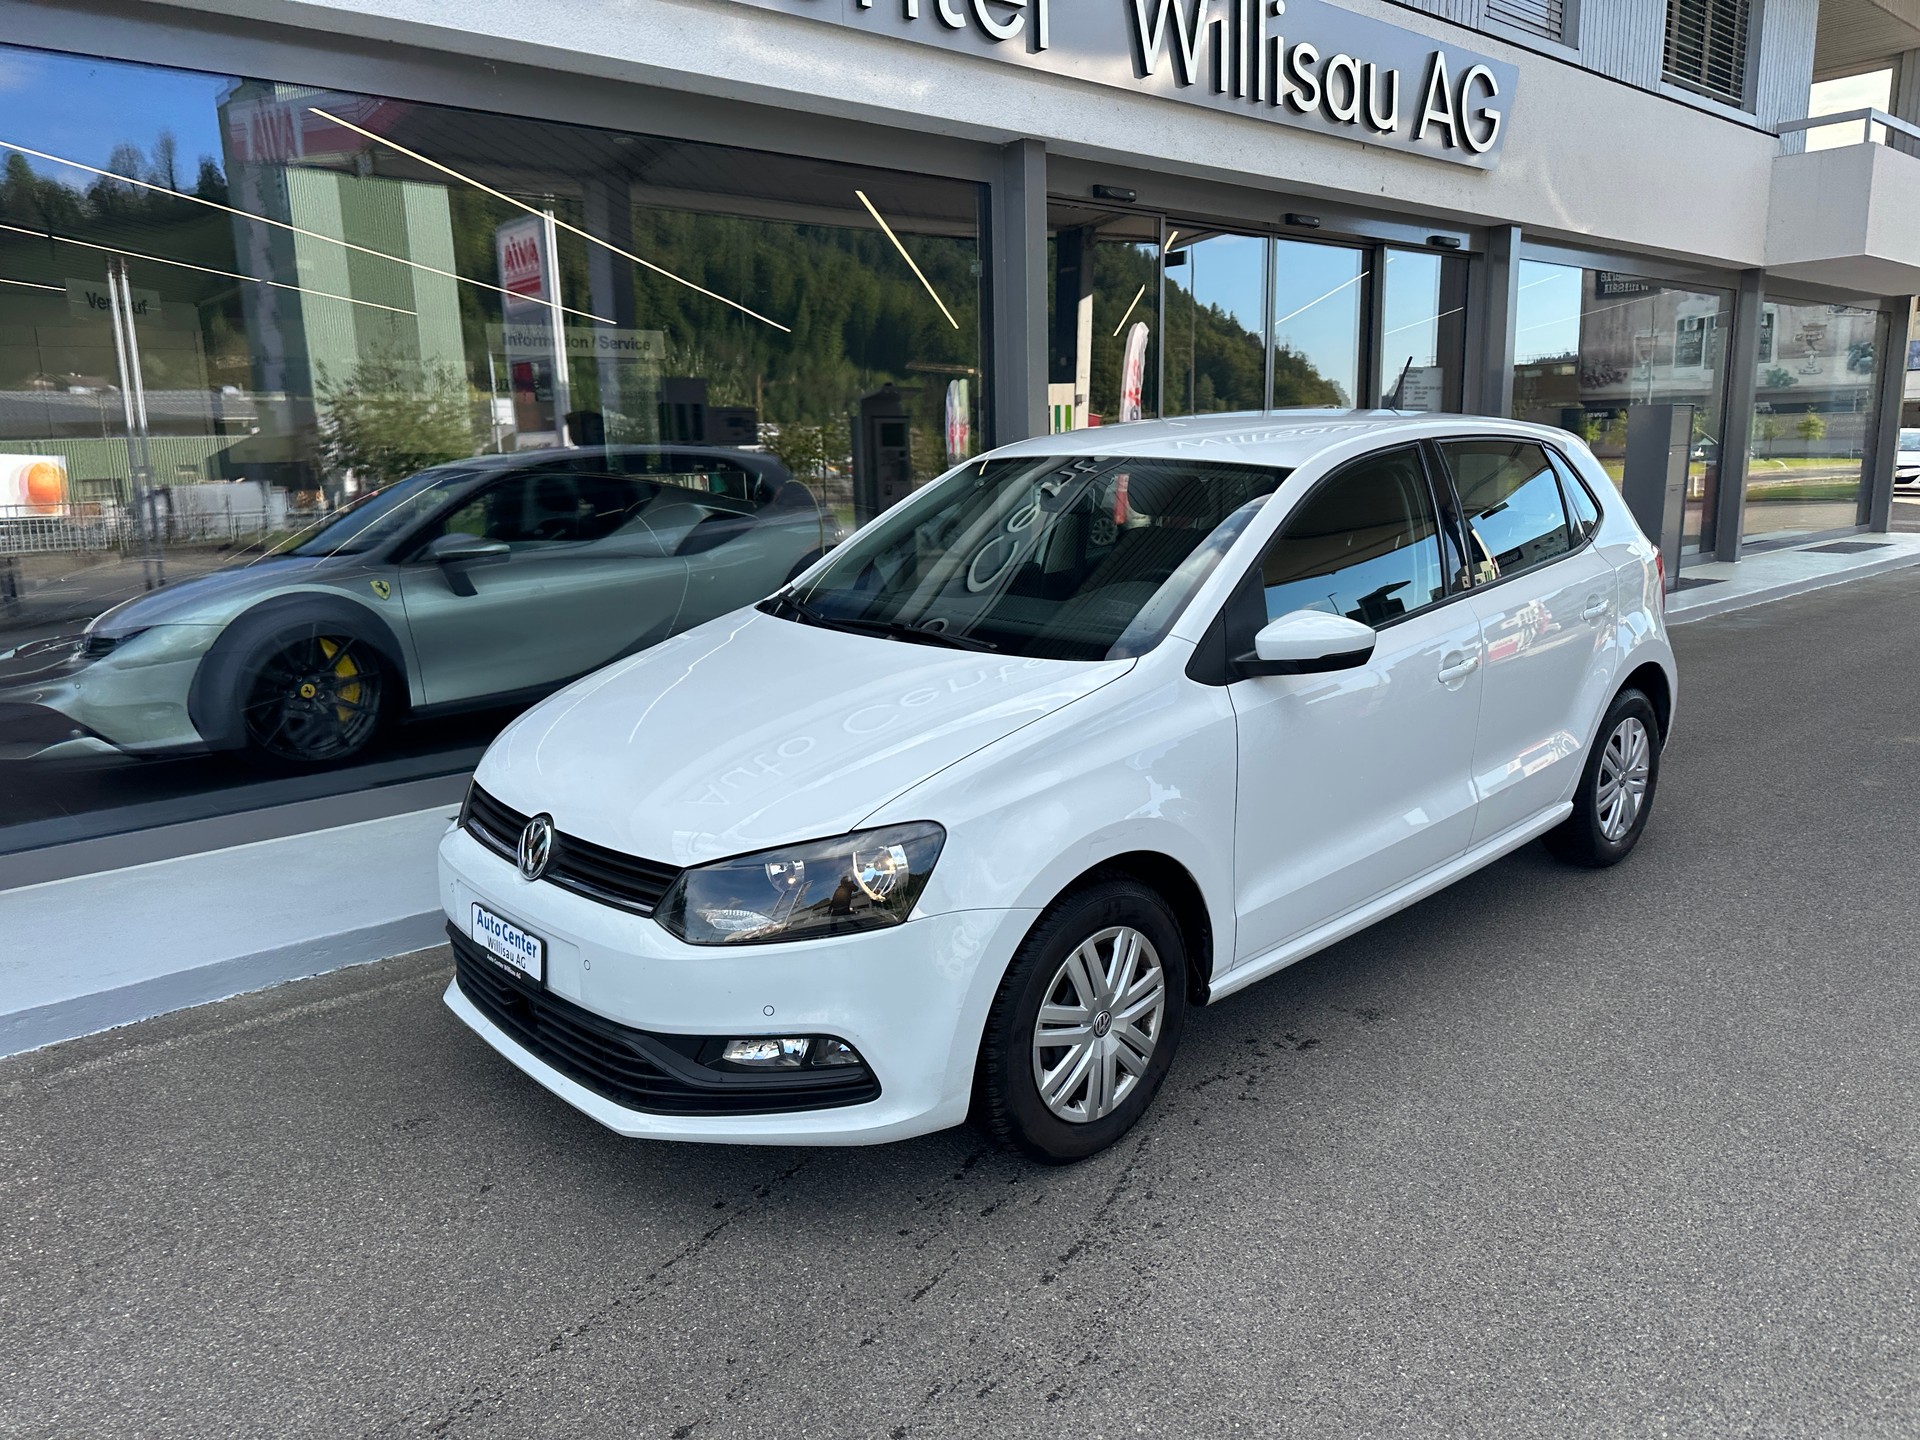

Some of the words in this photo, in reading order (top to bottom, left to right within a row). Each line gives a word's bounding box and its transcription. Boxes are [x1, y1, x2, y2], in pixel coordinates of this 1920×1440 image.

[1128, 0, 1398, 131] Willisau
[1413, 50, 1501, 154] AG
[599, 335, 651, 351] Service
[487, 936, 515, 961] Willisau
[516, 953, 526, 969] AG
